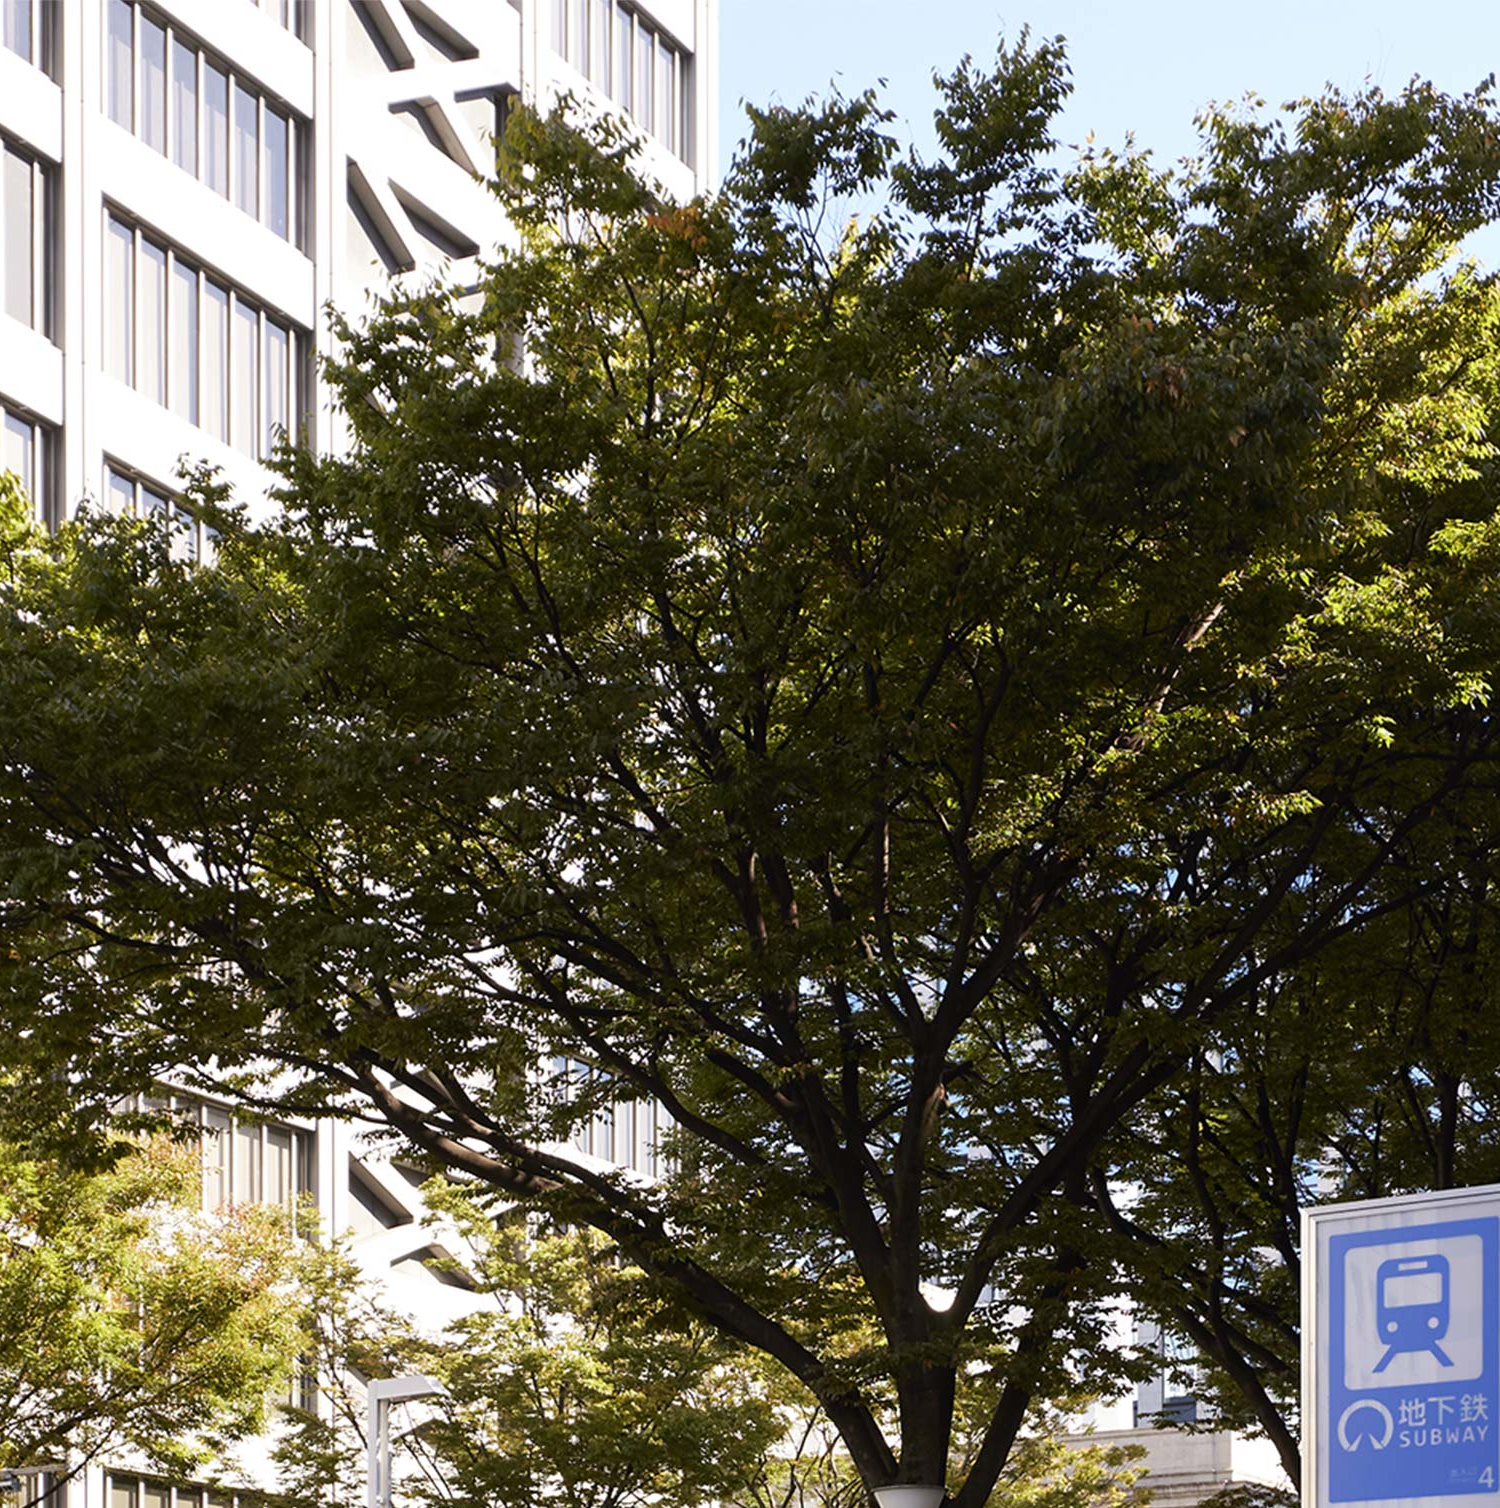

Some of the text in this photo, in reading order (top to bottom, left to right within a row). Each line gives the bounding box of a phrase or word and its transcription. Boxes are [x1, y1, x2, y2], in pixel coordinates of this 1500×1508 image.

[1398, 1393, 1489, 1427] 地下鉄
[1399, 1425, 1489, 1449] SUBWAY
[1478, 1465, 1495, 1489] 4
